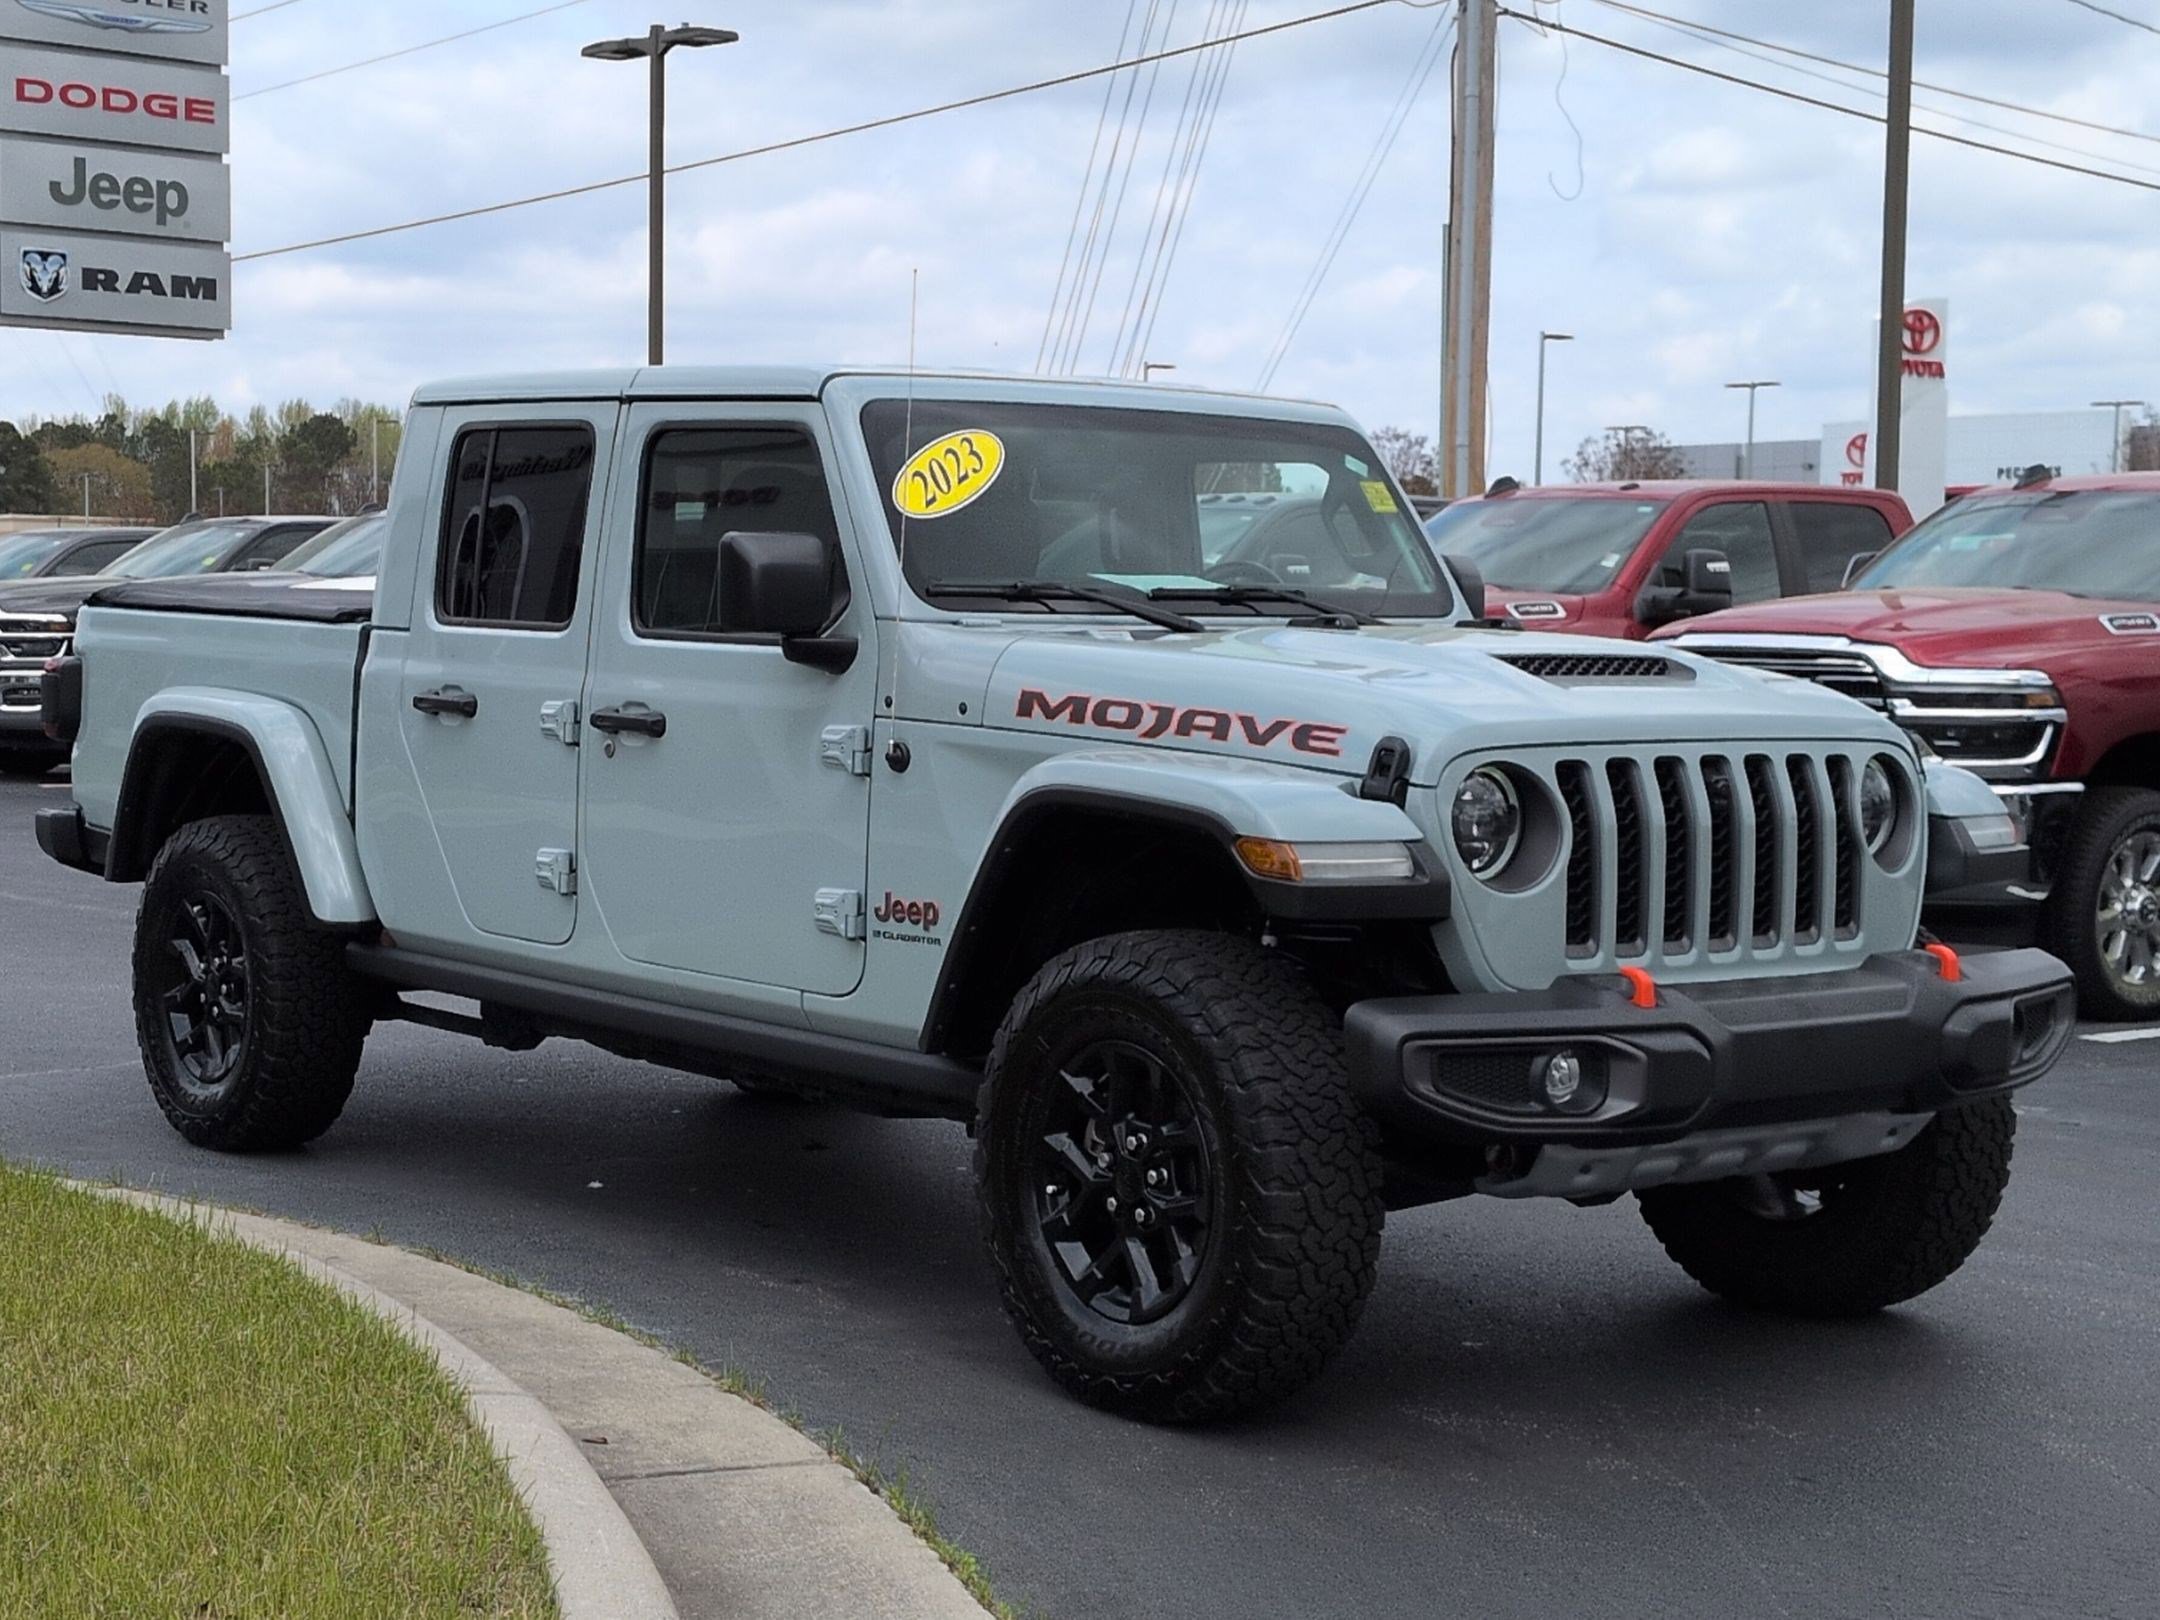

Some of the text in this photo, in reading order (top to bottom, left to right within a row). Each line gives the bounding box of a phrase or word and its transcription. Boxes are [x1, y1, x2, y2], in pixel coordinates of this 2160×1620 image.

[15, 78, 216, 125] DODGE
[49, 156, 189, 226] Jeep
[81, 267, 217, 300] RAM
[912, 437, 983, 508] 2023
[1015, 688, 1348, 757] MOJAVE
[874, 891, 939, 932] Jeep
